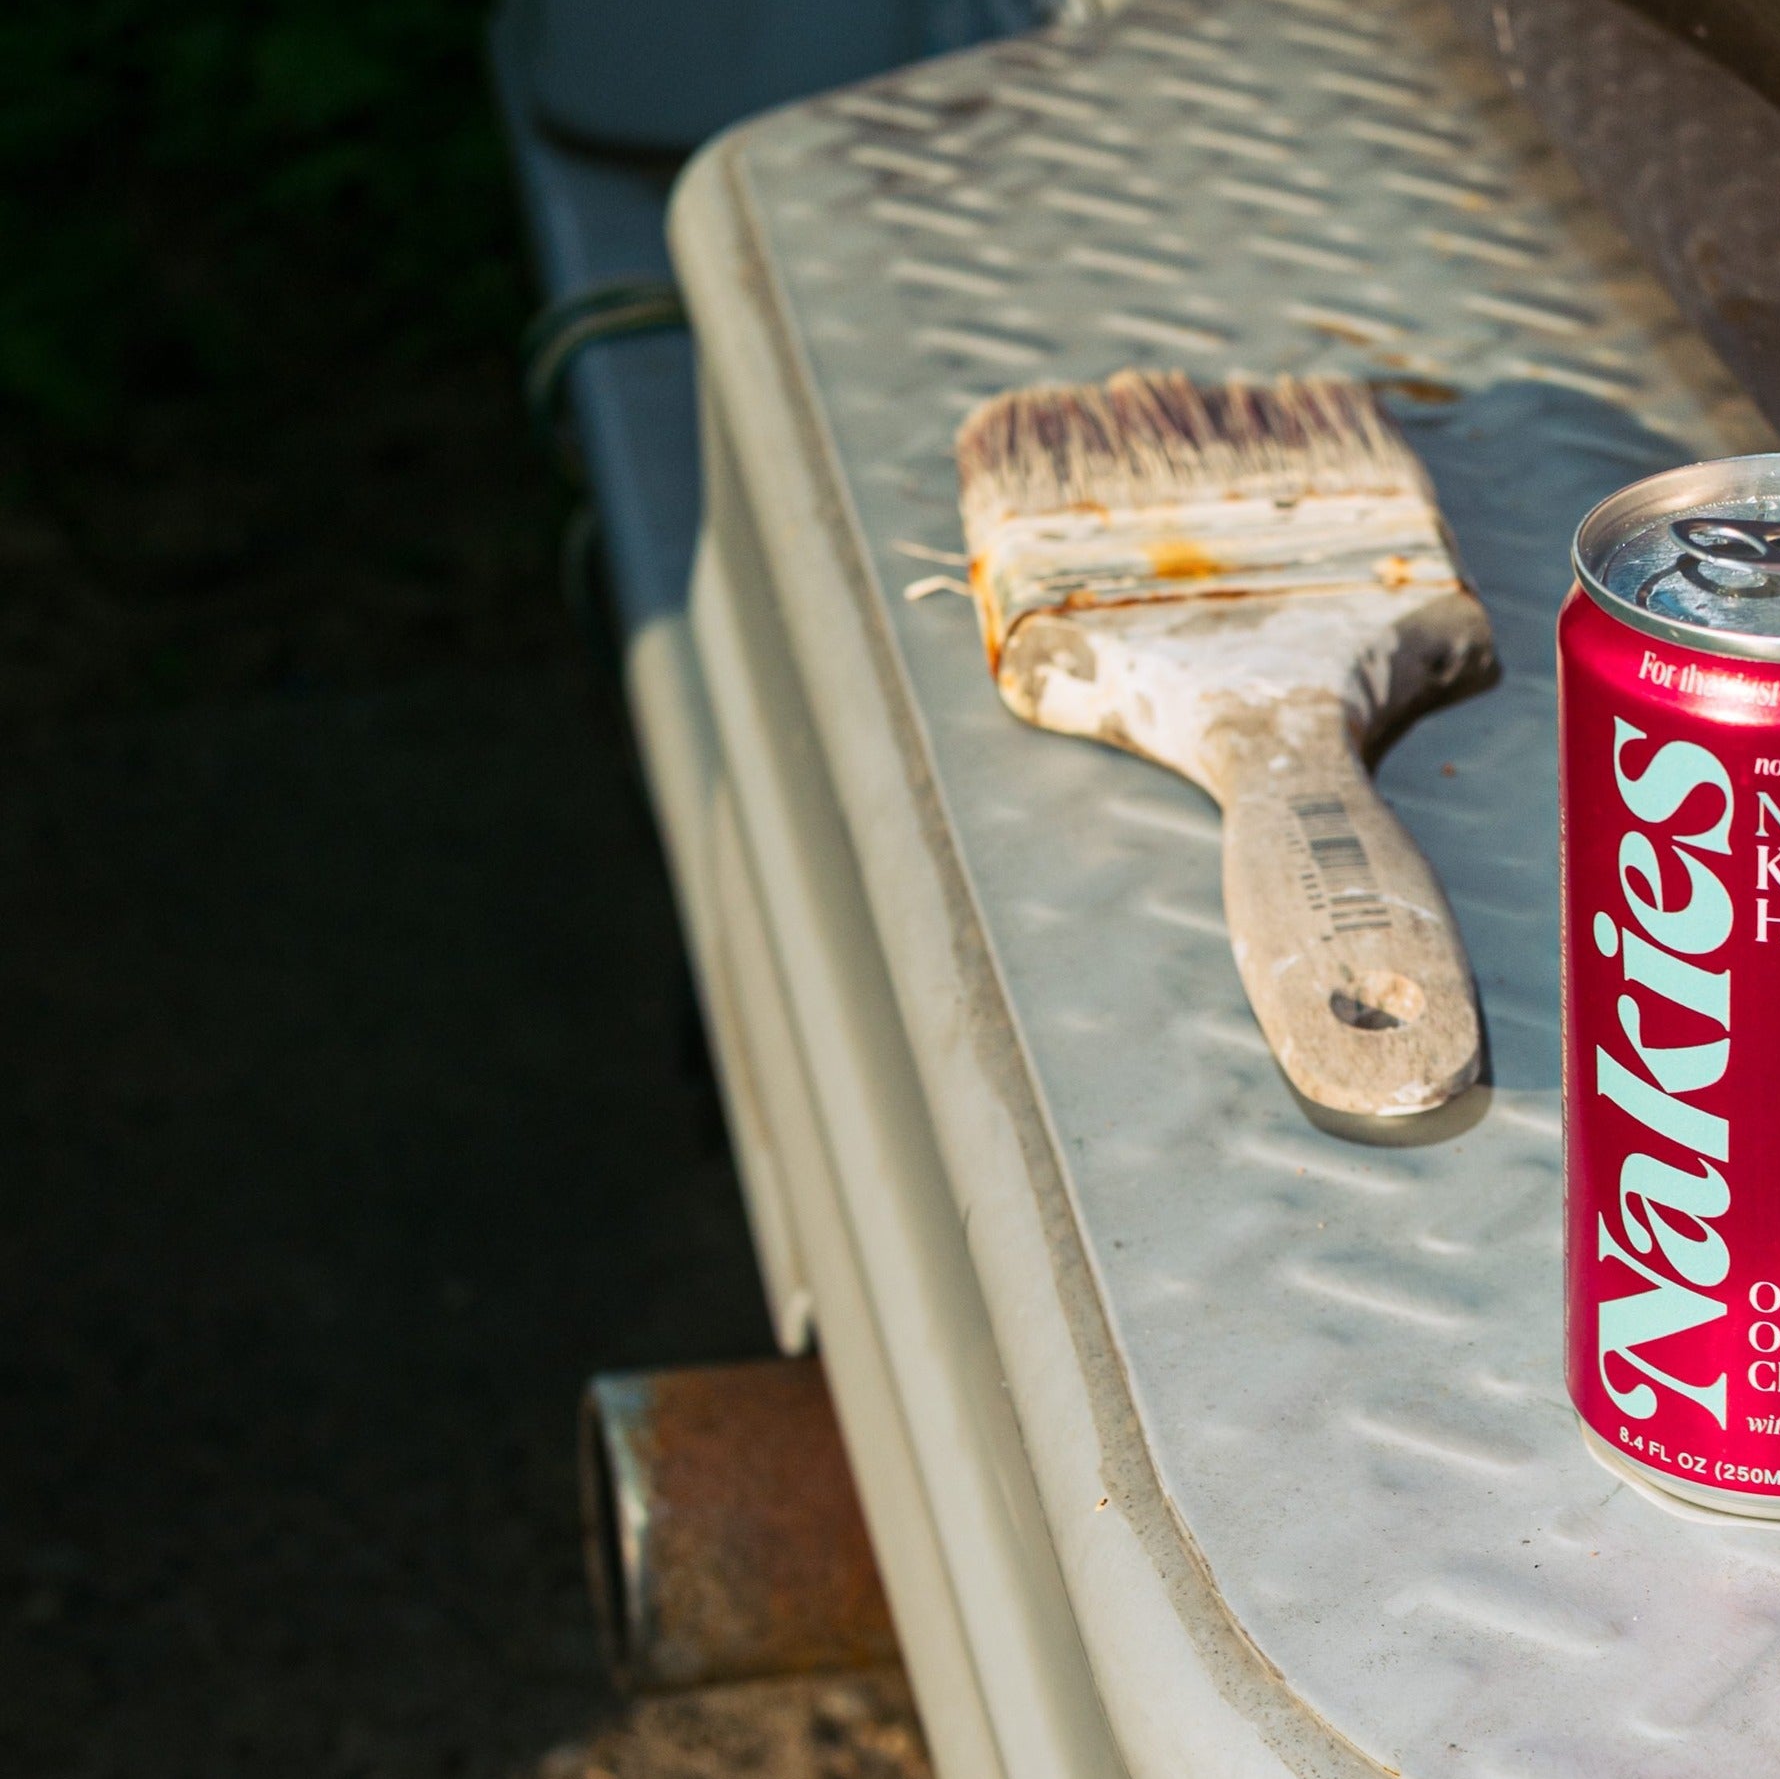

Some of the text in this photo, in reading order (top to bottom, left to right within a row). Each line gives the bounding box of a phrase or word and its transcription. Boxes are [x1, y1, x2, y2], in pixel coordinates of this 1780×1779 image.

[1638, 650, 1678, 686] For
[1594, 715, 1735, 1431] Nakies
[1619, 1426, 1644, 1451] 8.4
[1648, 1440, 1672, 1463] FL
[1677, 1452, 1708, 1474] OZ
